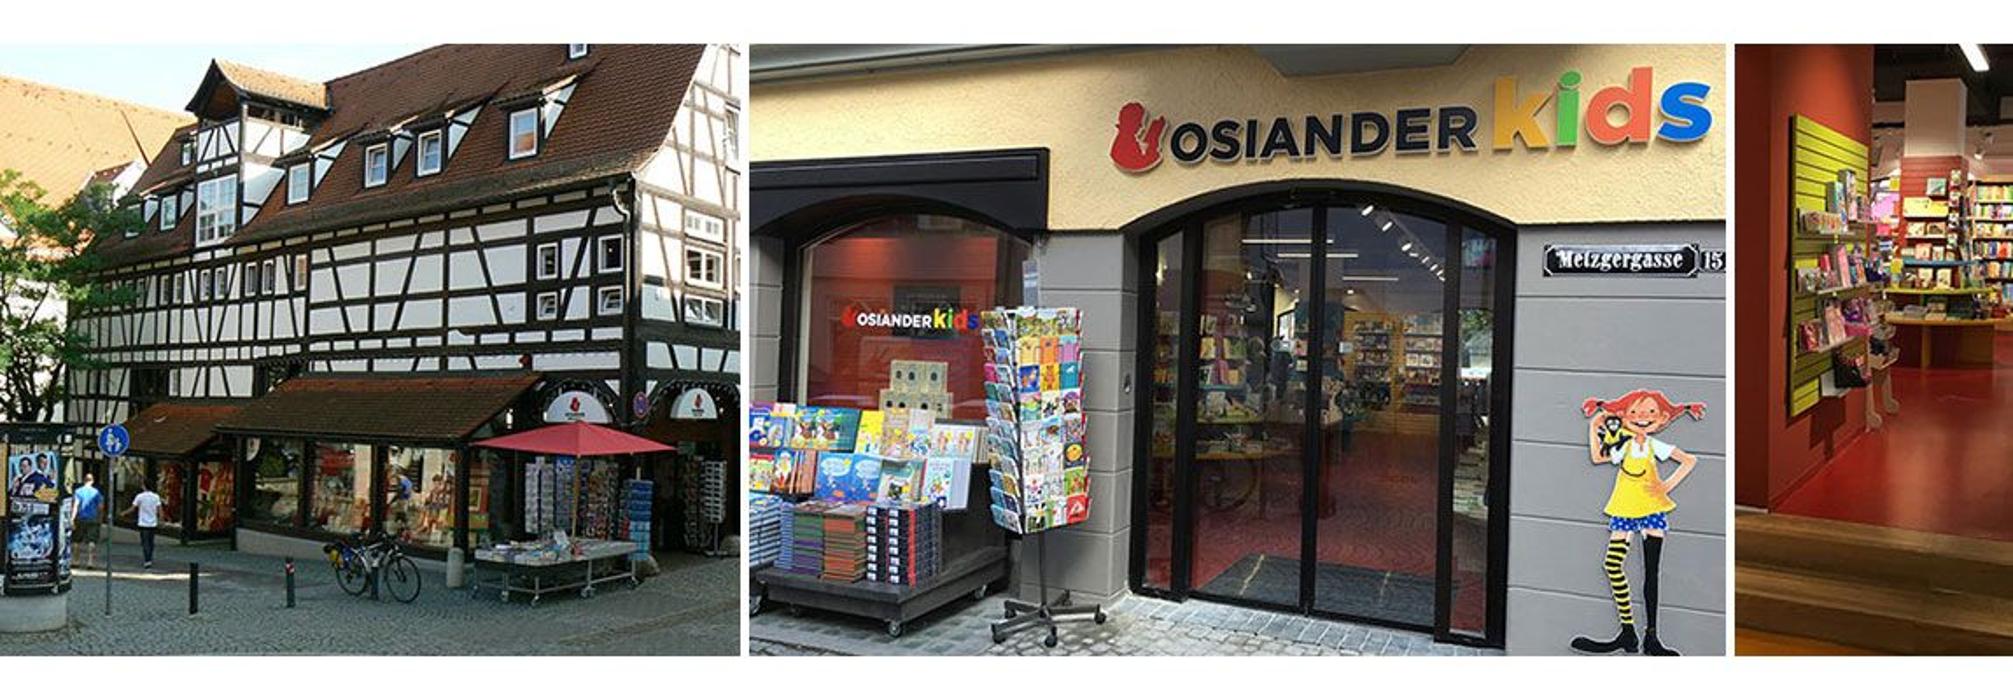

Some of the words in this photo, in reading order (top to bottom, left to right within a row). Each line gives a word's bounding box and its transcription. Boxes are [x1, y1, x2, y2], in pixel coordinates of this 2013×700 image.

[1170, 105, 1479, 164] OSIANDER
[1492, 66, 1713, 151] kids
[1556, 250, 1684, 272] Metzgergasse
[1704, 251, 1724, 270] 15
[856, 312, 933, 329] OSIANDER
[934, 307, 979, 333] kids
